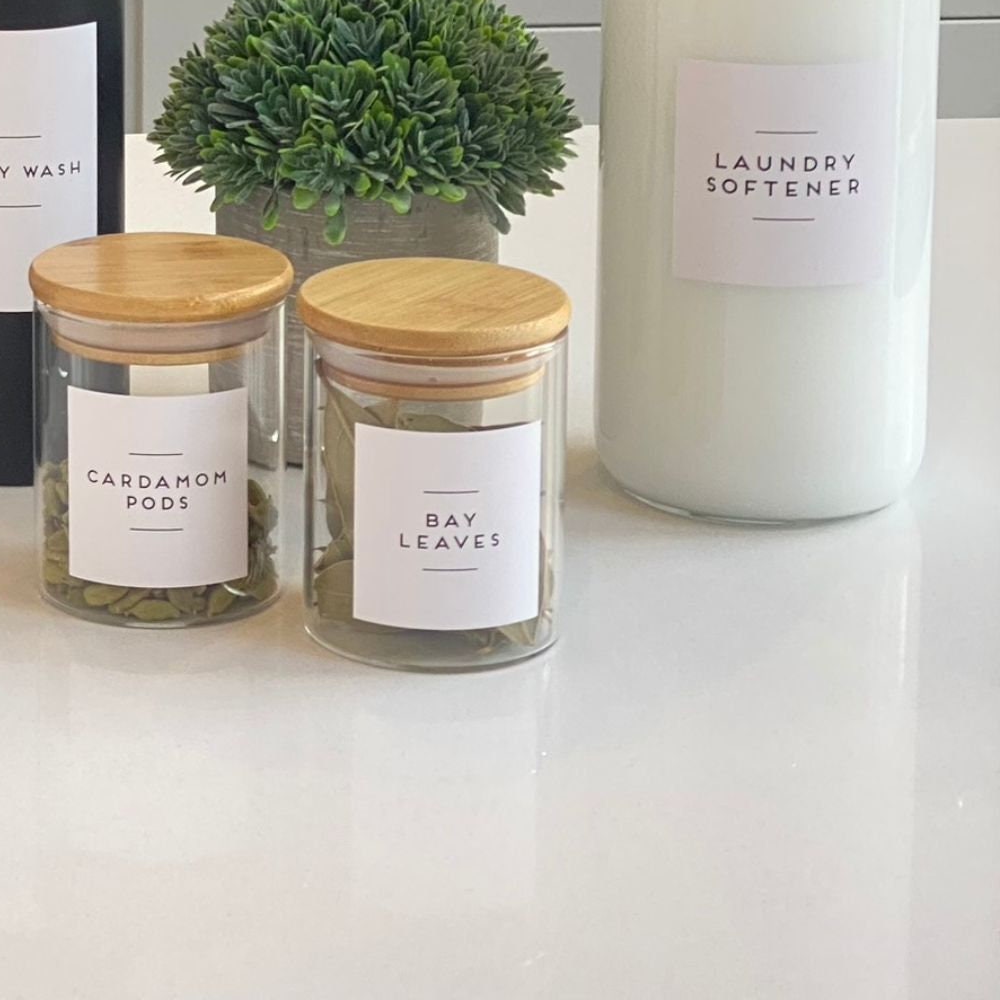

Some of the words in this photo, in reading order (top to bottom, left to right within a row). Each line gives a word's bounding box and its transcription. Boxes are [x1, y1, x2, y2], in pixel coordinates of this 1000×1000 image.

[22, 160, 81, 176] WASH
[714, 152, 856, 172] LAUNDRY
[705, 176, 860, 197] SOFTENER
[86, 469, 228, 489] CARDAMOM
[125, 494, 189, 512] PODS
[425, 512, 476, 529] BAY
[398, 531, 500, 550] LEAVES
